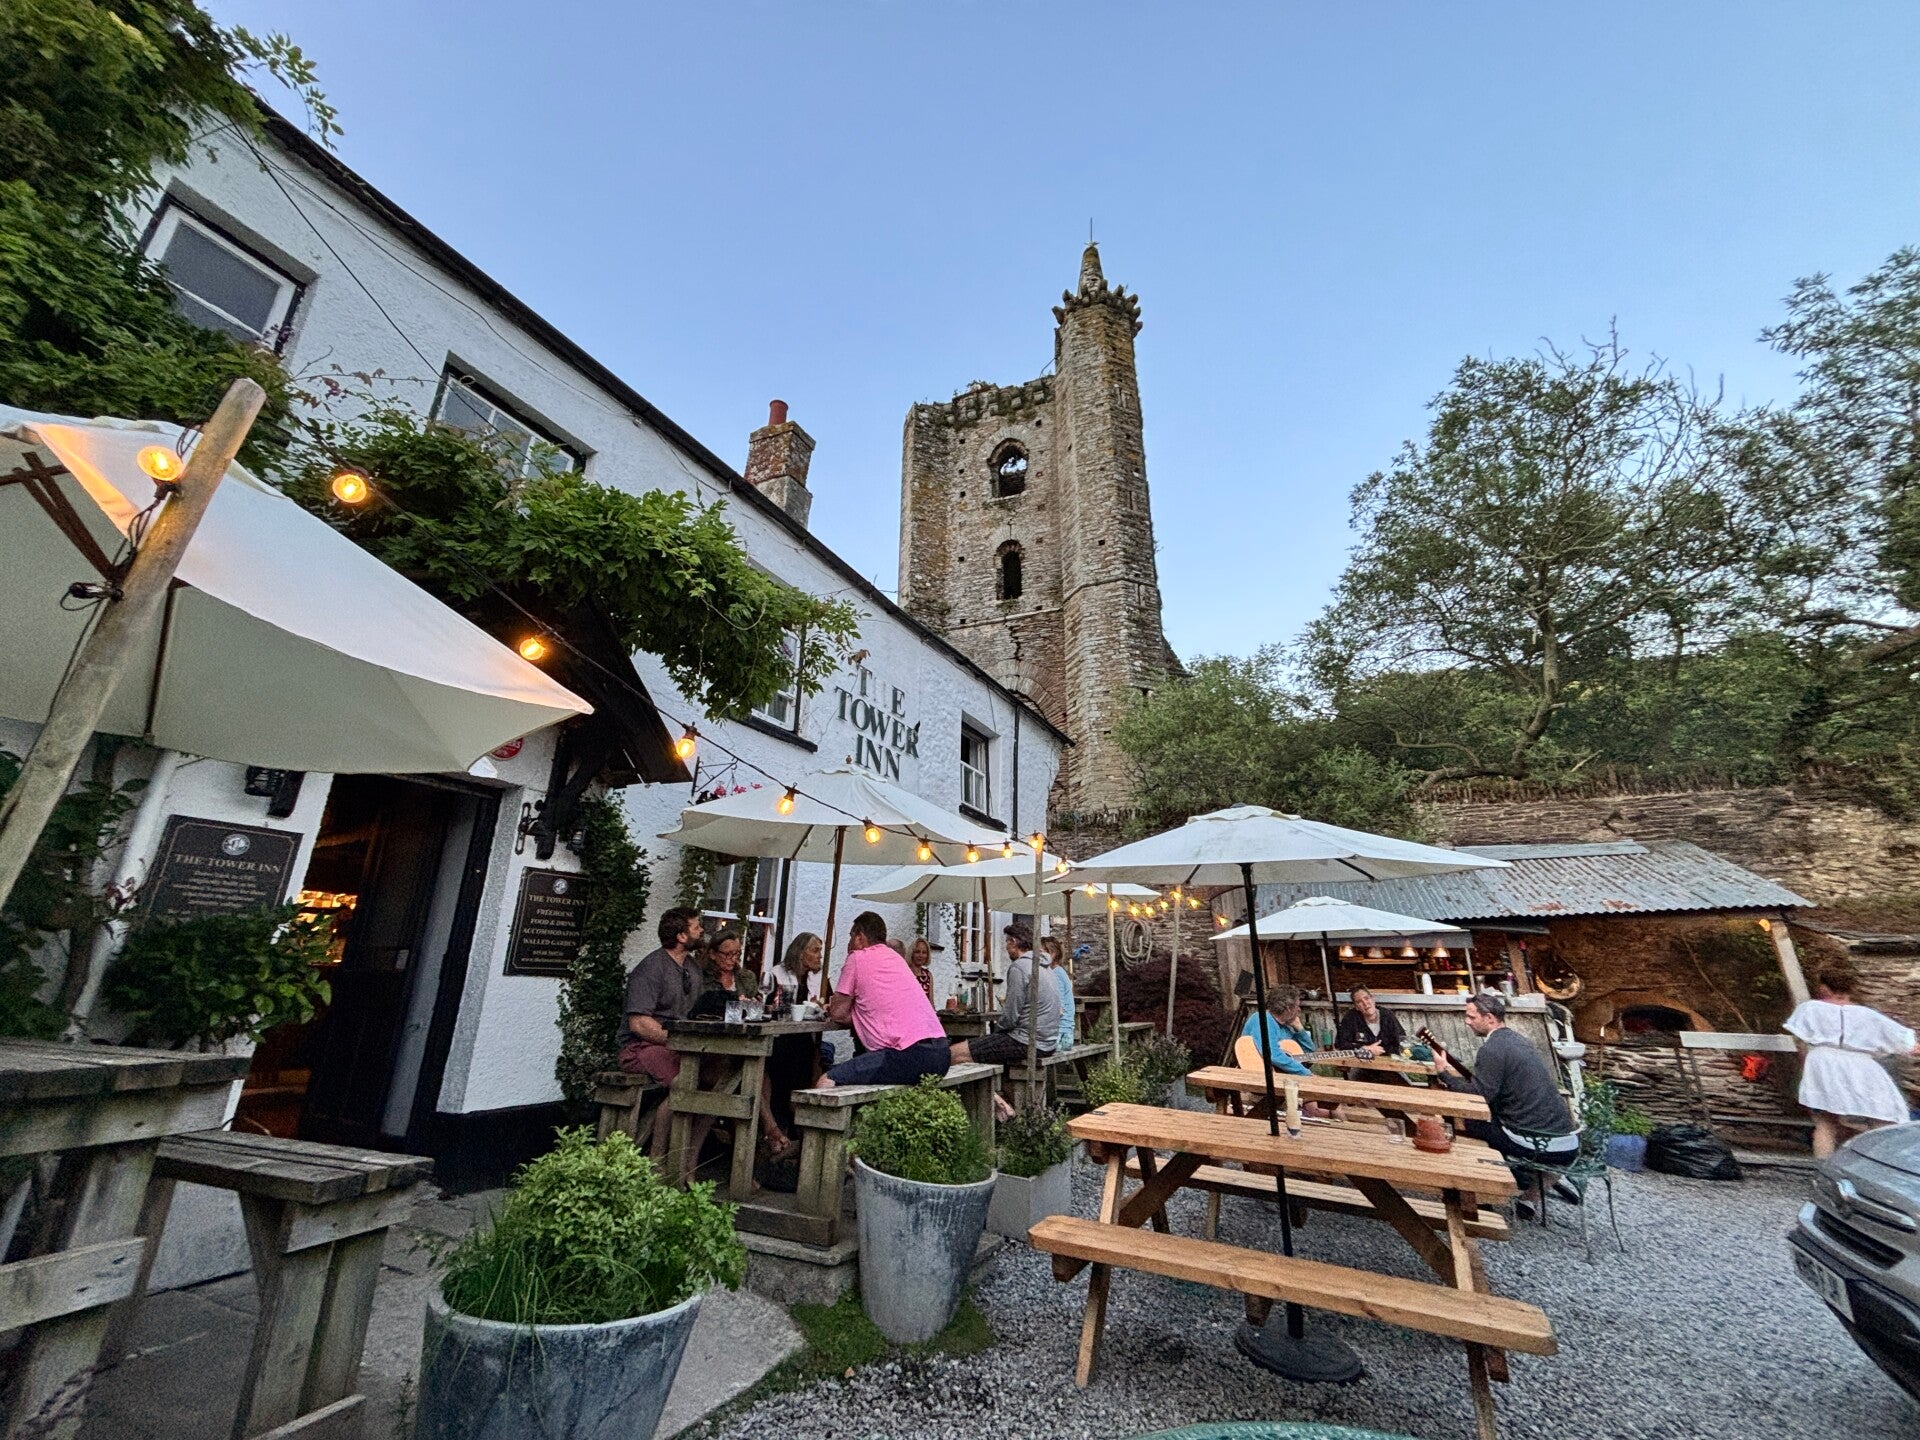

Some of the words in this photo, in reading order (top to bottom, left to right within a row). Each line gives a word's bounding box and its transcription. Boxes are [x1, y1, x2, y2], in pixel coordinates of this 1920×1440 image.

[857, 664, 905, 719] TE
[834, 685, 919, 760] TOWER
[855, 733, 901, 782] INN
[175, 854, 203, 865] THE
[208, 858, 256, 871] TOWER
[257, 864, 281, 873] INN
[528, 894, 545, 902] THE
[546, 896, 571, 904] TOWER
[523, 928, 580, 937] ACCOMMODATION
